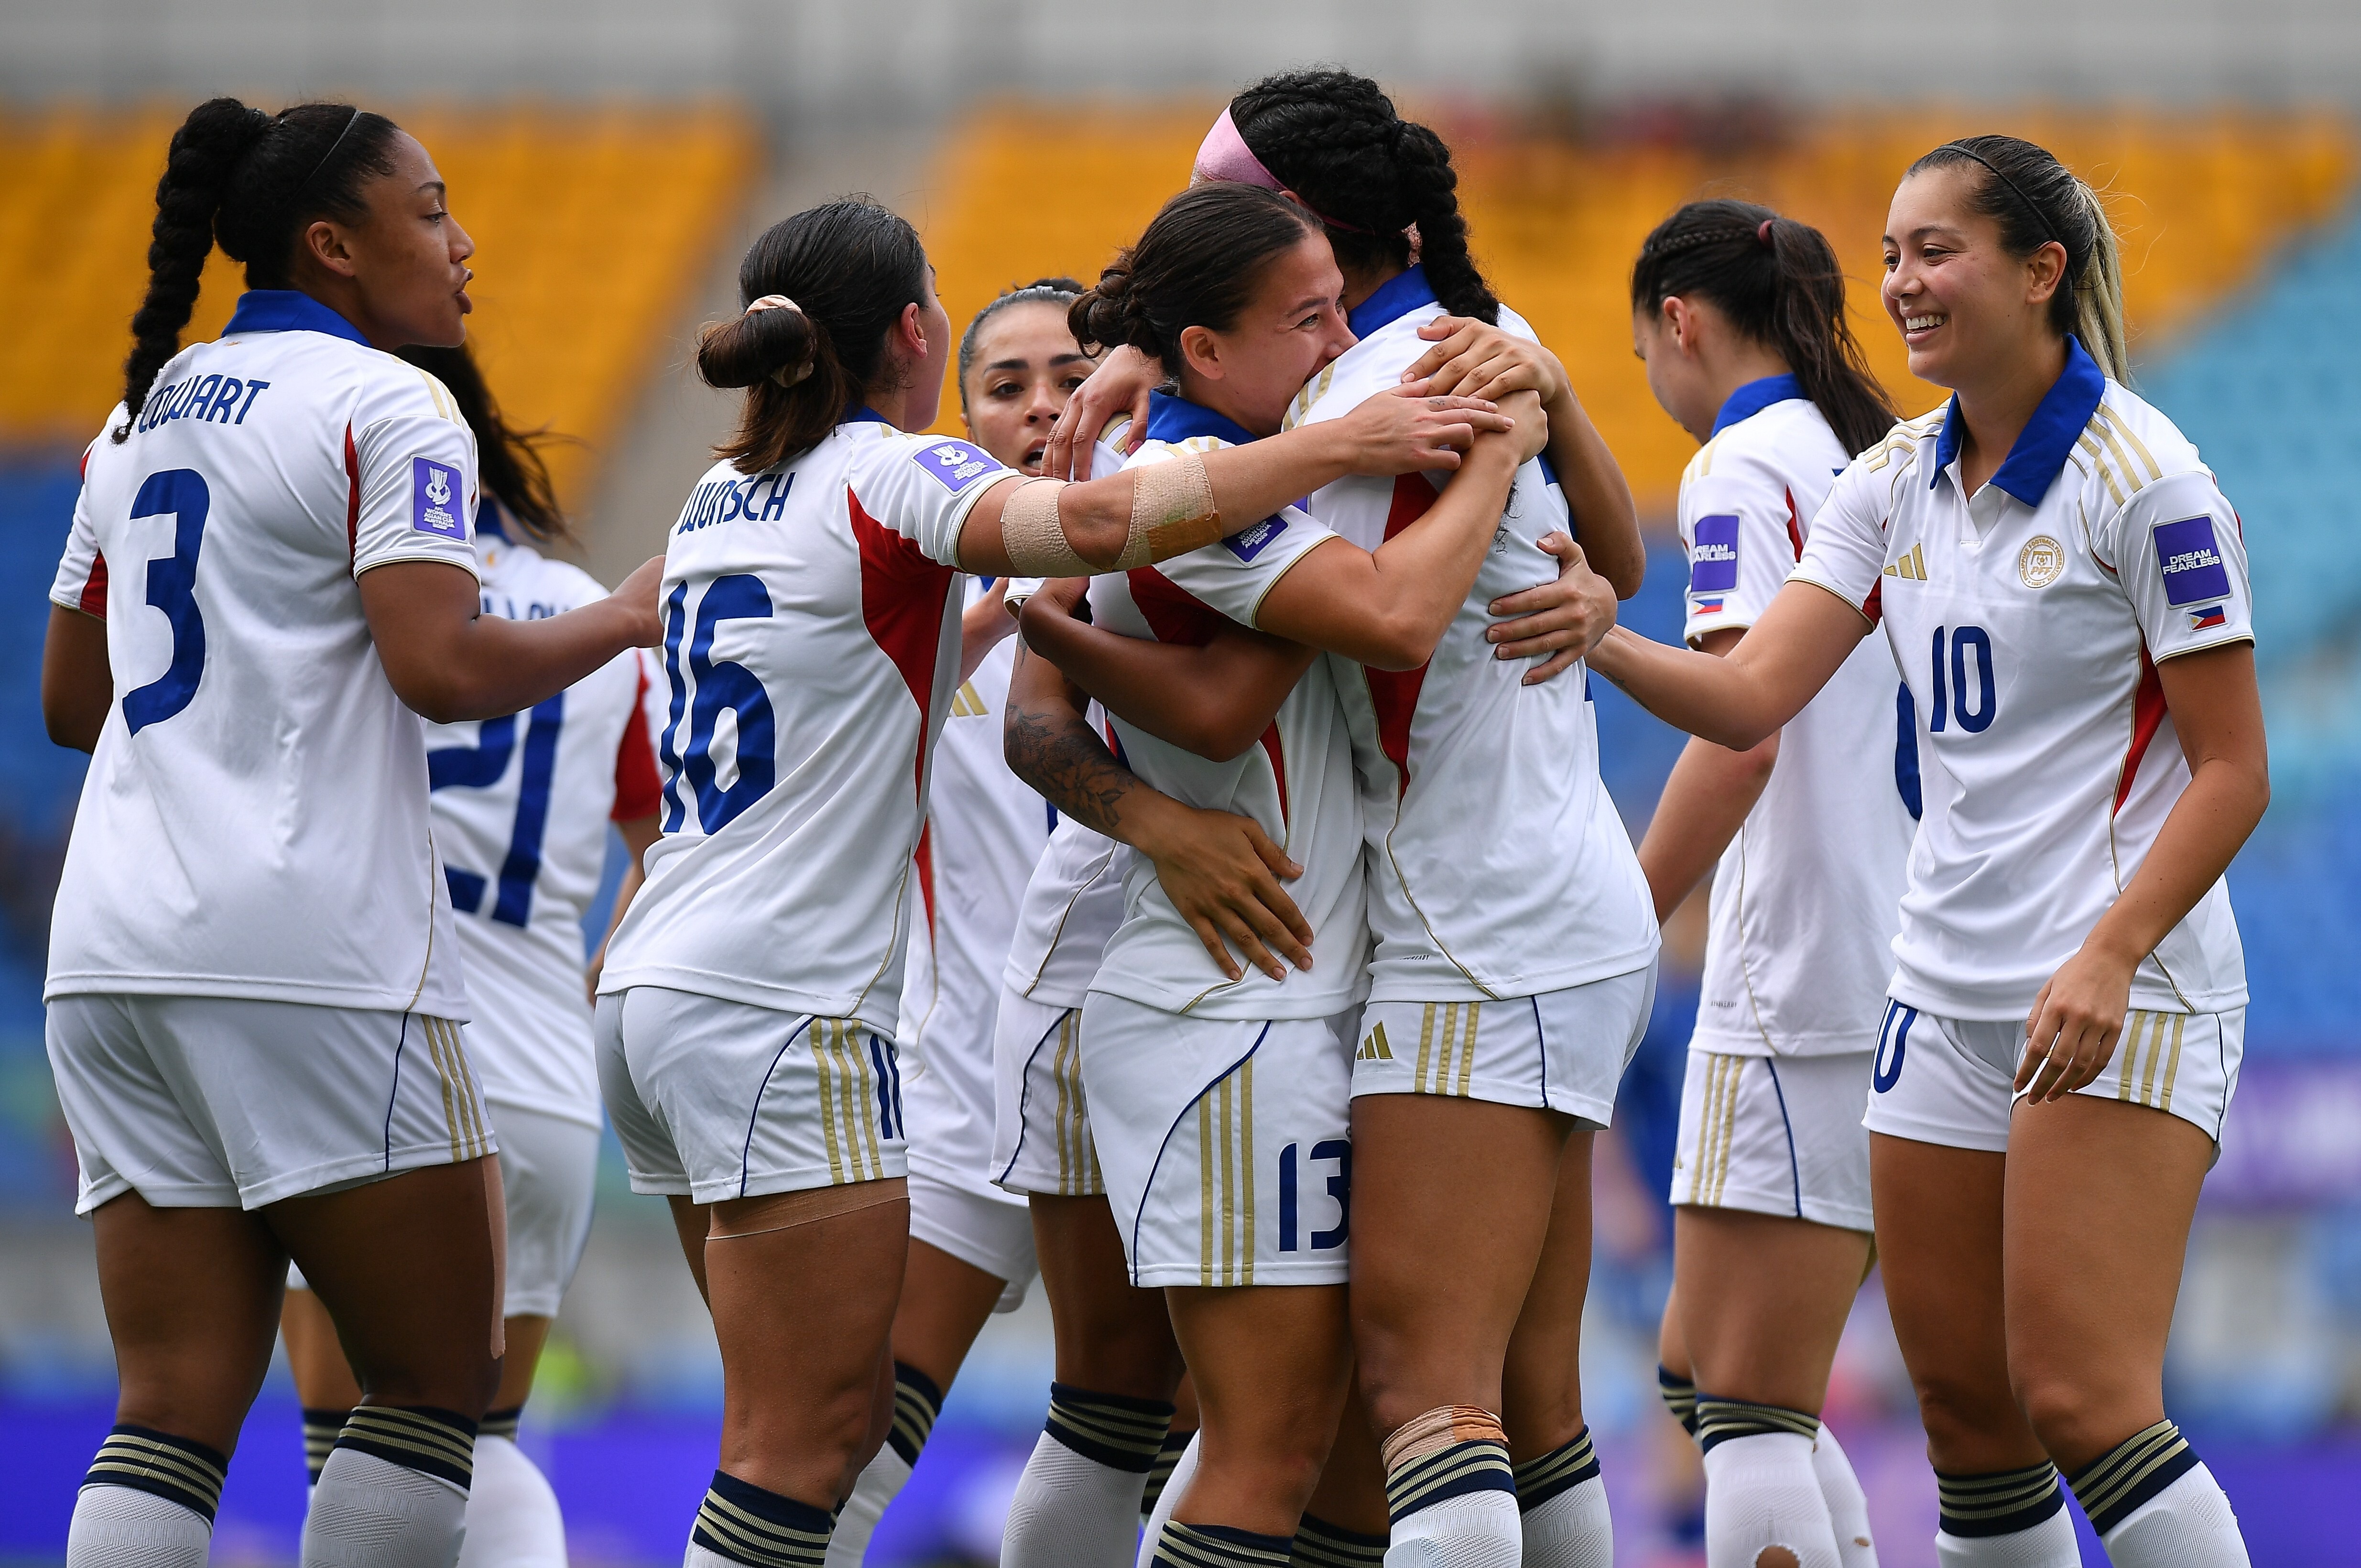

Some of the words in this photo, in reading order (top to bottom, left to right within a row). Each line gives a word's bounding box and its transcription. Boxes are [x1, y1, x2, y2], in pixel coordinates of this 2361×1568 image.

[138, 374, 272, 434] COWART
[677, 471, 797, 536] WUNSCH
[424, 512, 442, 521] ASIAN
[424, 517, 455, 528] AUSTRALIA
[1241, 529, 1257, 546] ASIAN
[1256, 520, 1267, 531] CUP
[1245, 524, 1272, 548] AUSTRALIA
[1695, 543, 1729, 554] REAM
[1695, 551, 1736, 561] ARLESS
[2169, 548, 2212, 565] DREAM
[2162, 555, 2221, 575] FEARLESS
[122, 468, 210, 739] 3
[1929, 625, 1996, 733] 10
[661, 573, 775, 836] 16
[1278, 1139, 1352, 1252] 13
